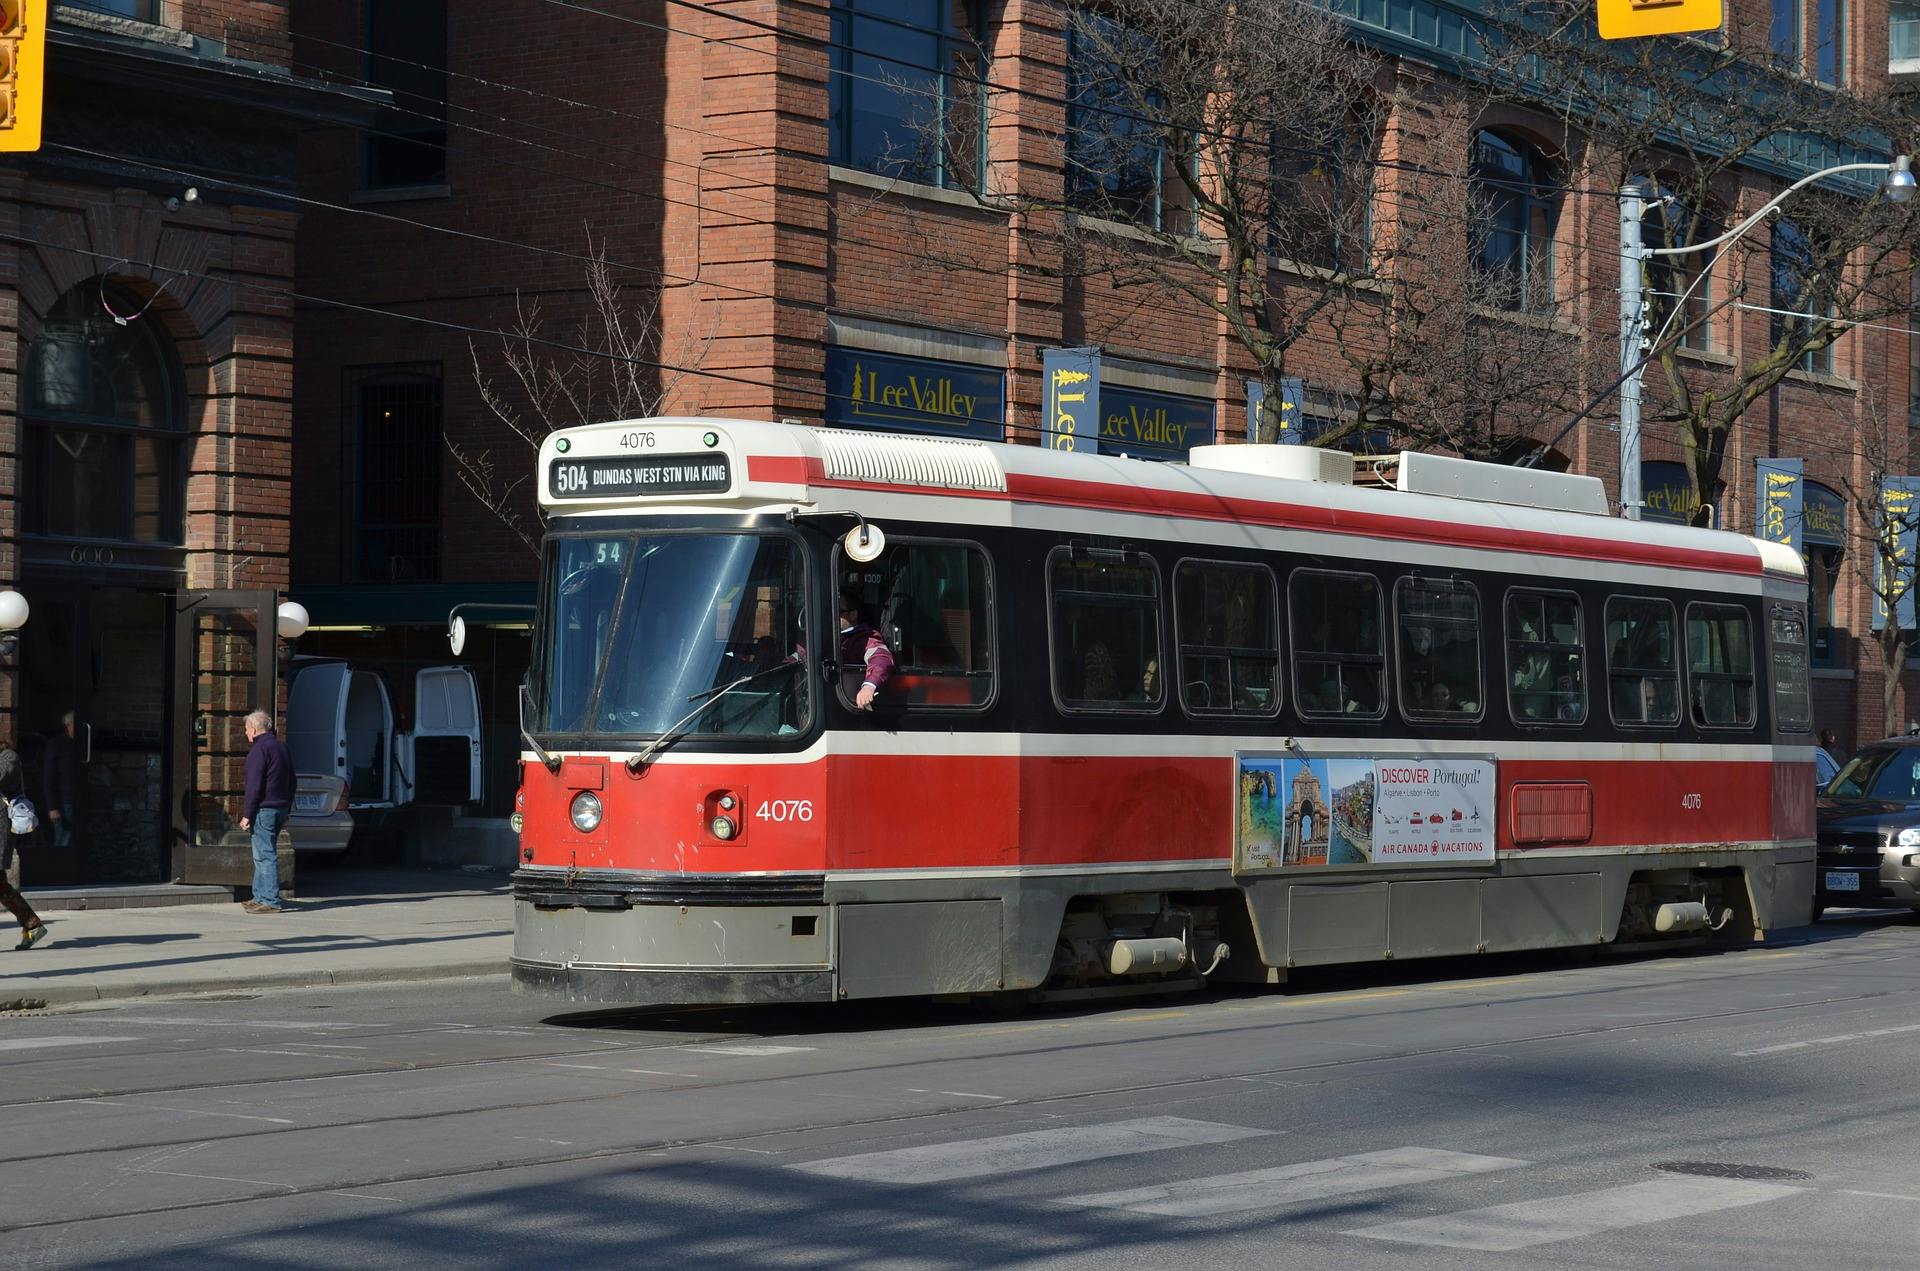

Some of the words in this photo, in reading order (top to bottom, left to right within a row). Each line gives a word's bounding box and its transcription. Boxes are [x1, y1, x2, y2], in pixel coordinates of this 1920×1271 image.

[868, 371, 909, 407] Lee
[908, 375, 977, 420] Valley
[1057, 391, 1086, 451] Lee
[1100, 413, 1129, 437] ee
[1129, 405, 1188, 448] Valley
[620, 432, 656, 449] 4076
[558, 465, 588, 491] 504
[593, 468, 632, 485] DUNDAS
[633, 467, 662, 484] WEST
[663, 466, 682, 483] STN
[683, 465, 701, 482] VIA
[701, 464, 726, 481] KING
[1642, 489, 1664, 509] ee
[1769, 490, 1792, 536] Lee
[70, 545, 114, 566] 600
[597, 542, 621, 563] 54
[1382, 768, 1429, 784] DISCOVER
[1433, 768, 1481, 788] Portugal!
[1406, 789, 1423, 797] Lisbon
[1427, 788, 1441, 797] Porto
[1681, 793, 1702, 809] 4076
[755, 799, 813, 822] 4076
[1382, 844, 1395, 855] AIR
[1396, 843, 1429, 854] CANADA
[1441, 841, 1484, 853] VACATIONS
